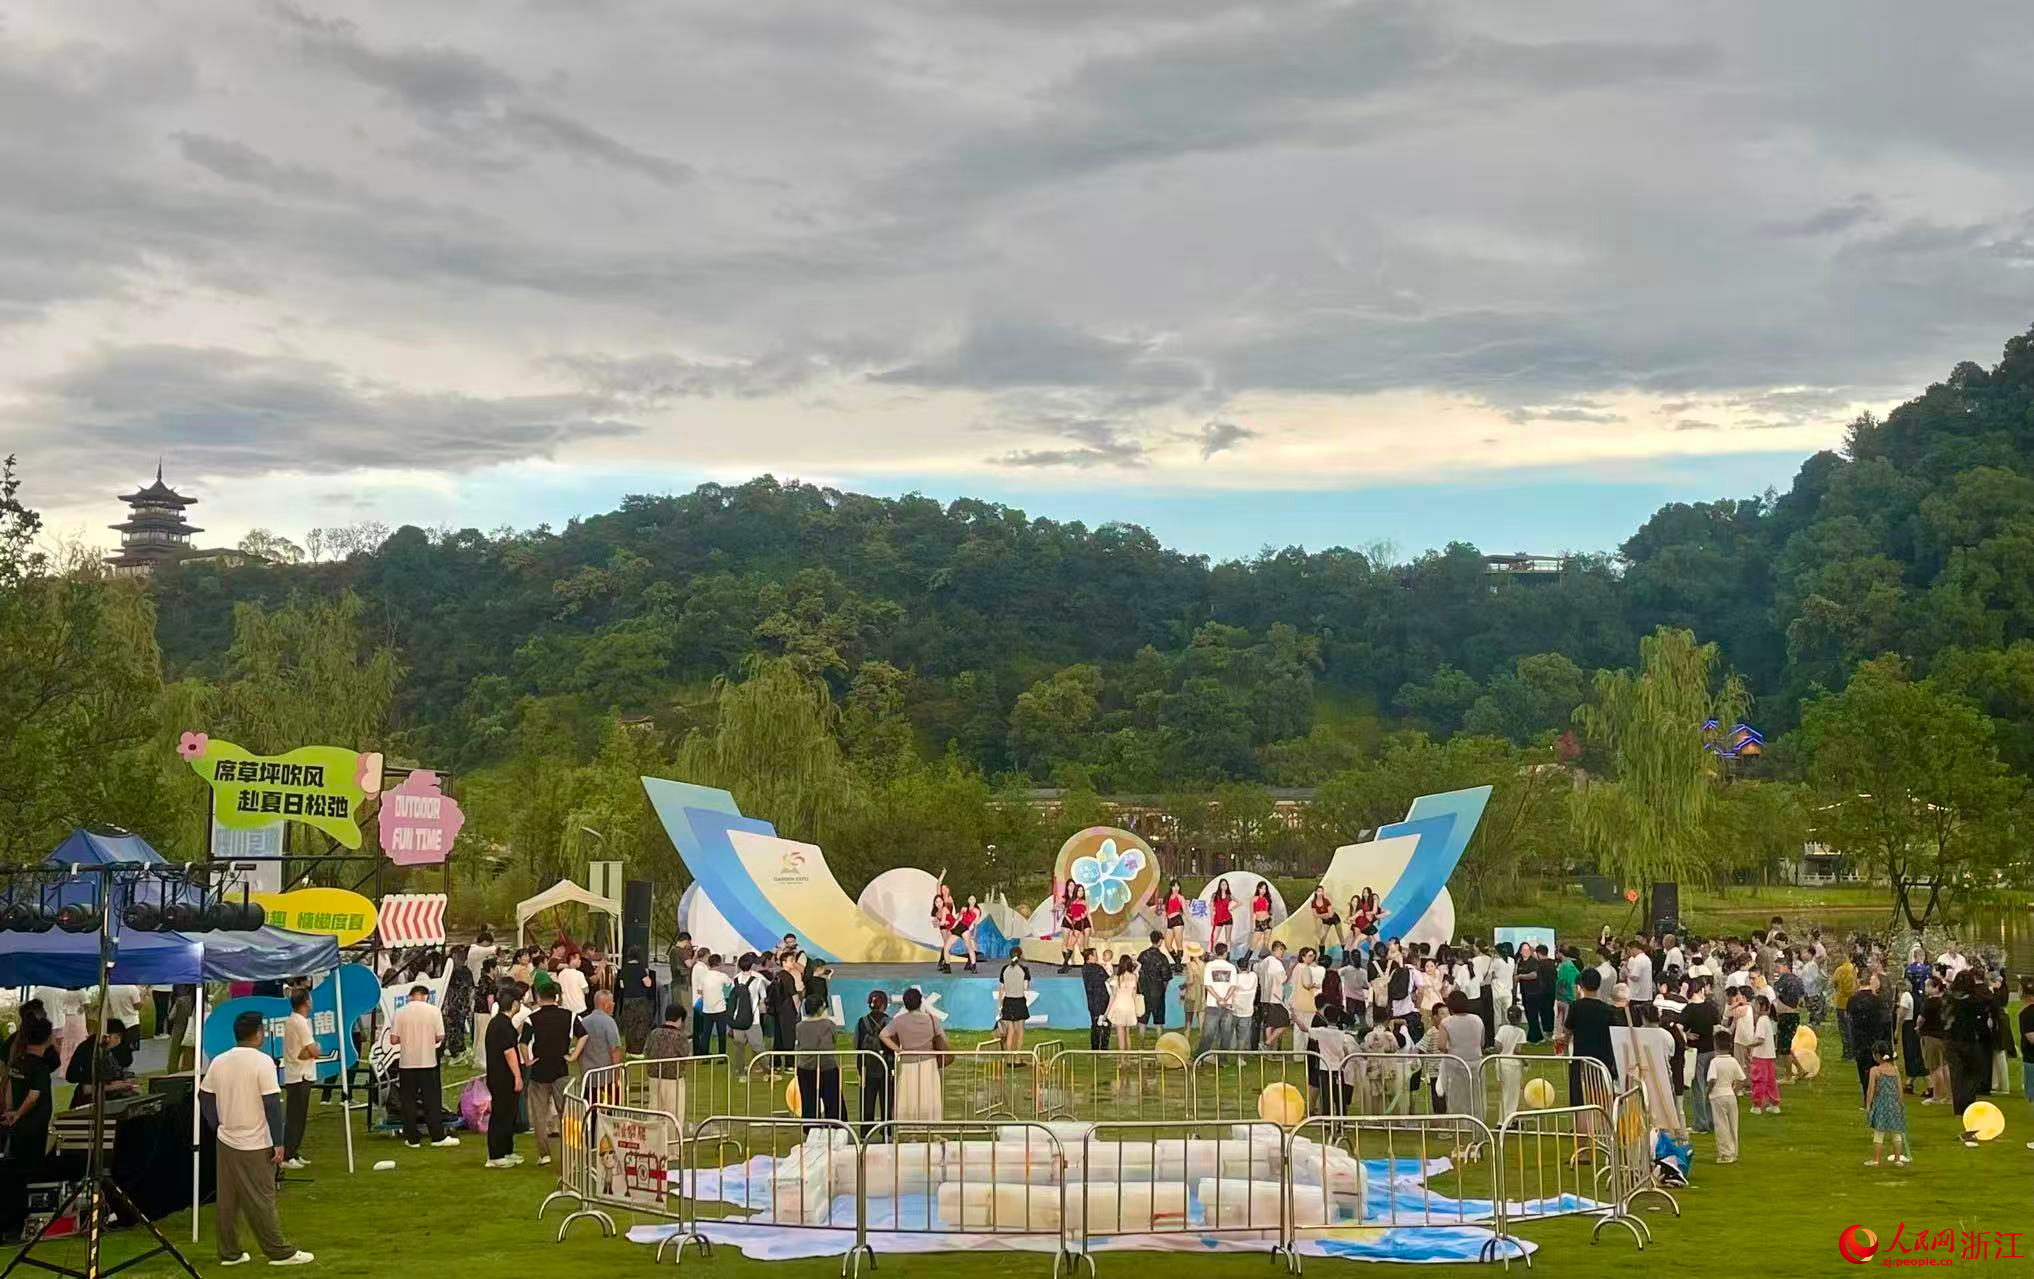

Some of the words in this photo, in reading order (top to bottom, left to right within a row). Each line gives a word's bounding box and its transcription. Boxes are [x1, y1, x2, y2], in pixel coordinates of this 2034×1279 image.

[214, 759, 324, 788] 席草坪吹风
[237, 790, 348, 819] 赴夏日松弛
[395, 795, 441, 819] OUTDOOR
[392, 827, 414, 851] FUN
[415, 828, 443, 852] TIME
